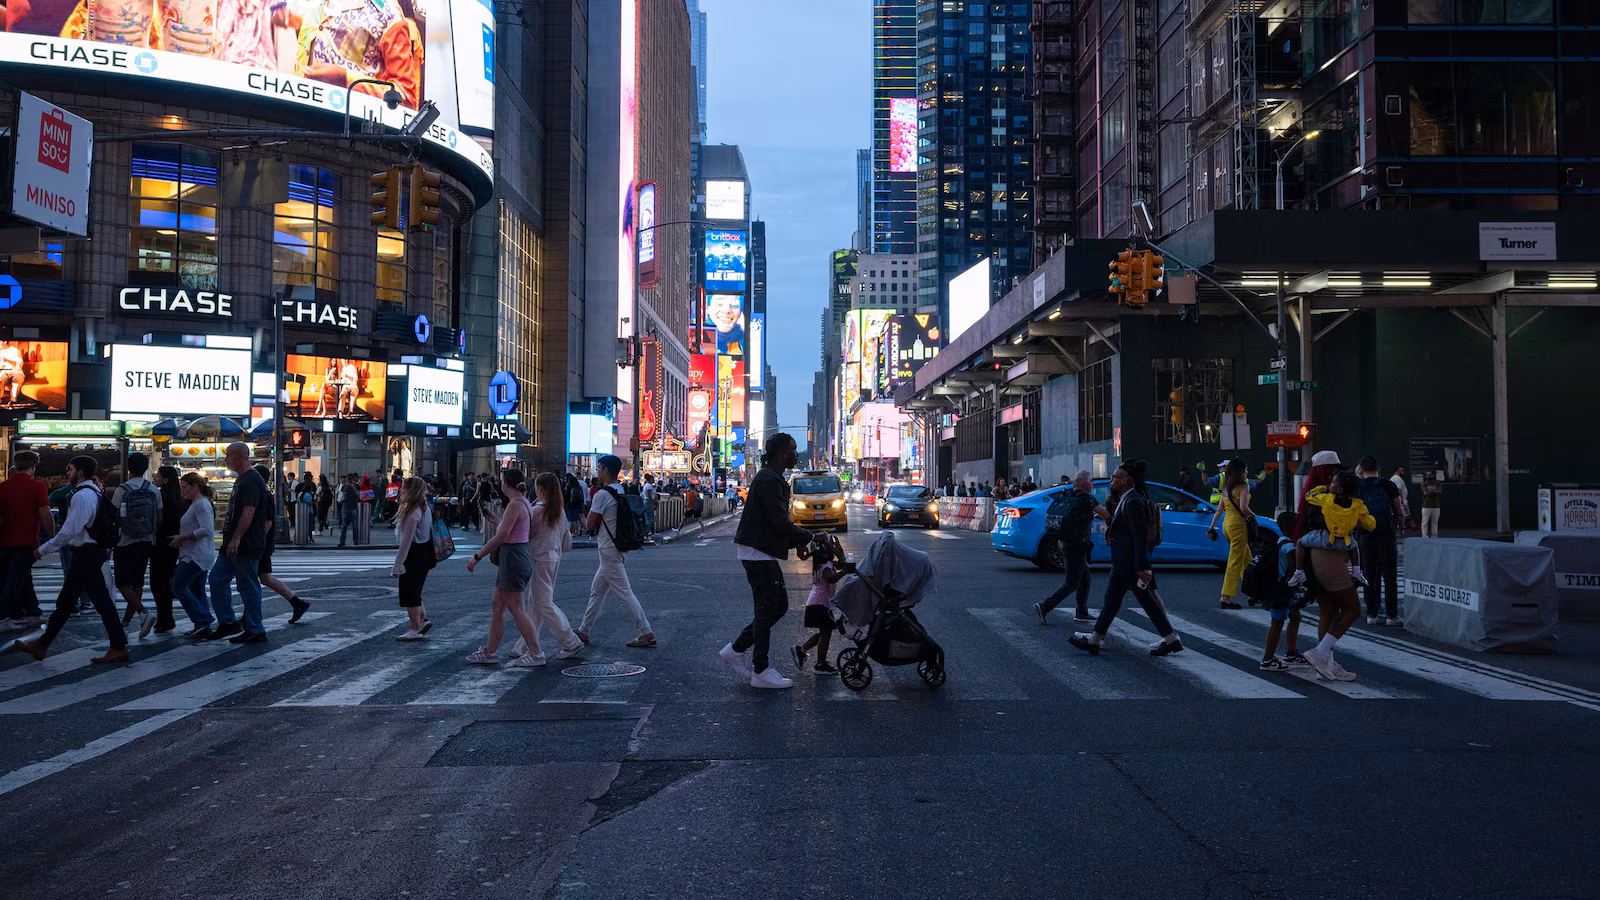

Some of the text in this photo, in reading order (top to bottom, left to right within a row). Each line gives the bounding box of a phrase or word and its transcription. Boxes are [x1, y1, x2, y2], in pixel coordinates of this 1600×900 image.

[30, 41, 128, 68] CHASE
[247, 72, 324, 103] CHASE
[43, 120, 69, 146] MINI
[26, 183, 76, 217] MINISO
[711, 232, 741, 241] britbox
[1498, 237, 1538, 249] Turner
[119, 287, 233, 317] CHASE
[273, 300, 358, 330] CHASE
[891, 335, 899, 367] XBOOM
[125, 370, 240, 391] STEVE MADDEN
[891, 368, 899, 380] LG
[1295, 381, 1301, 390] W
[1303, 381, 1311, 390] 42
[413, 387, 459, 406] STEVE MADDEN
[472, 422, 516, 440] CHASE
[1564, 499, 1598, 510] LITTLE SHOP
[1564, 510, 1598, 525] HORRORS
[1410, 581, 1471, 606] TIMES SQUARE
